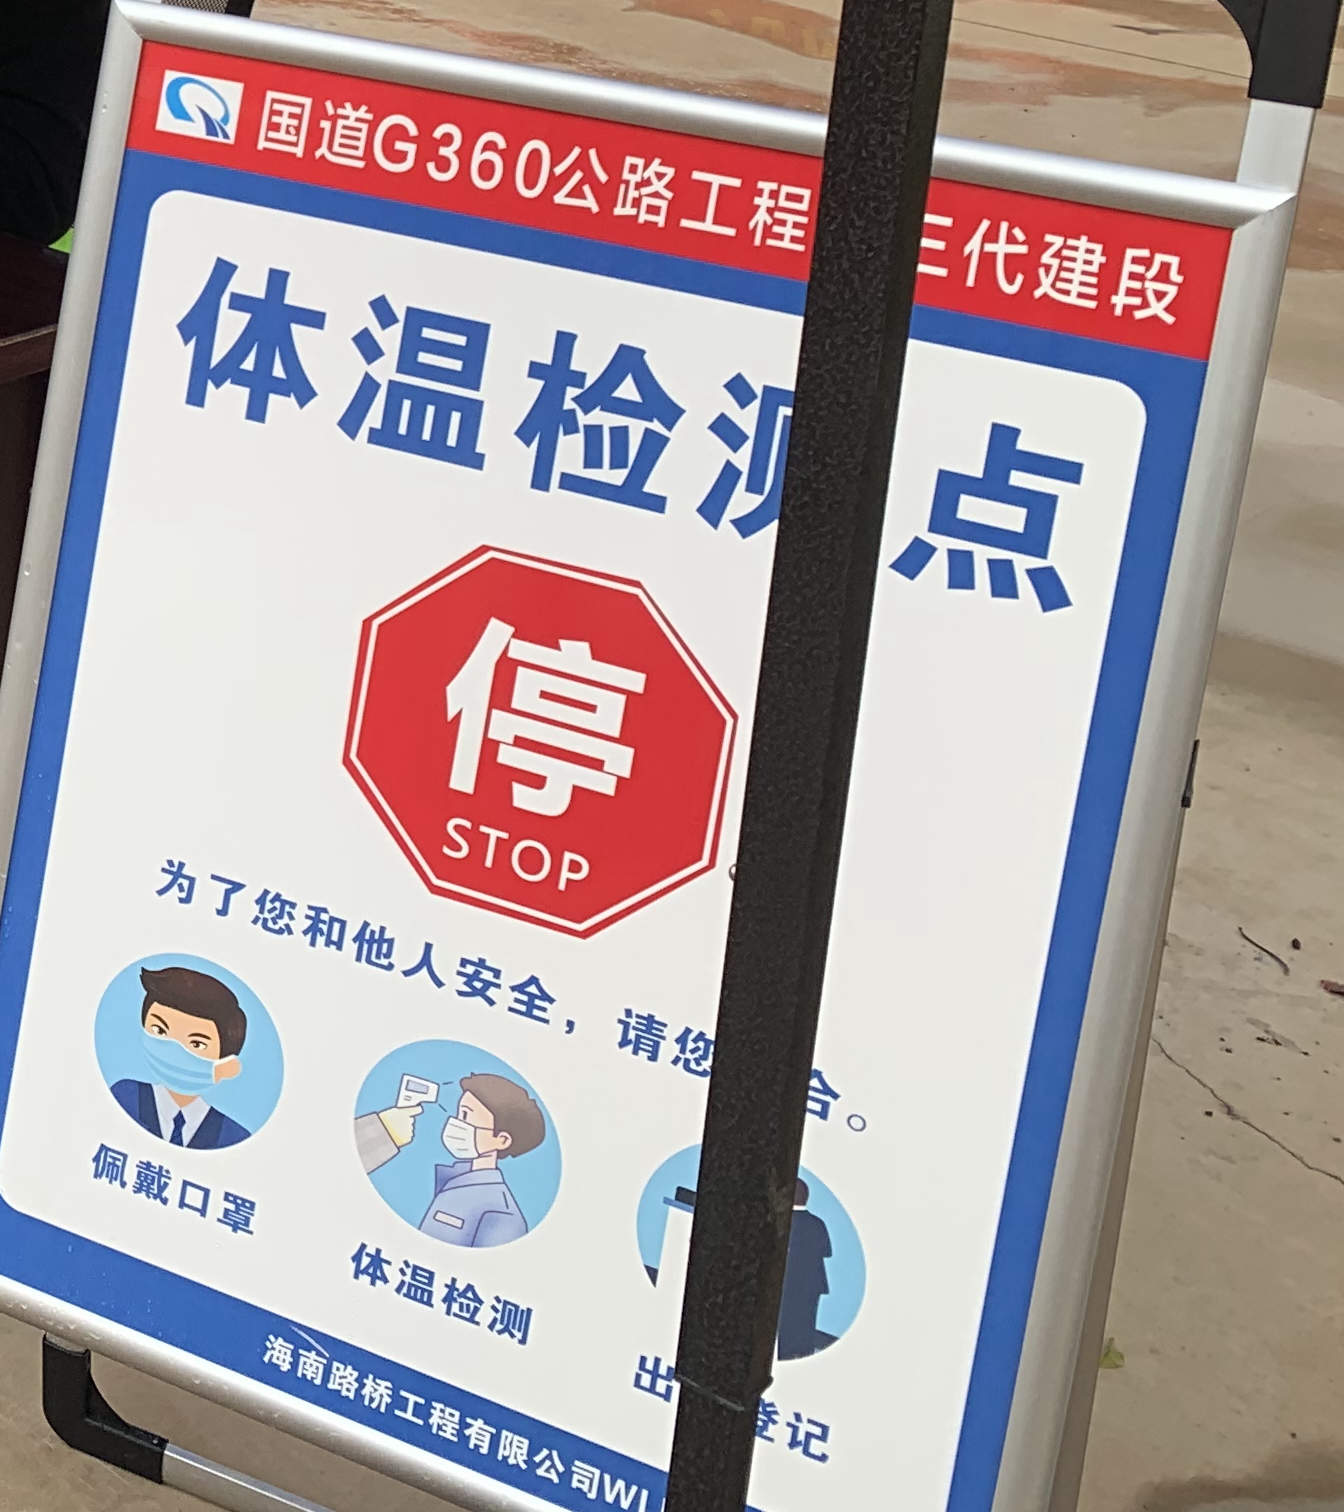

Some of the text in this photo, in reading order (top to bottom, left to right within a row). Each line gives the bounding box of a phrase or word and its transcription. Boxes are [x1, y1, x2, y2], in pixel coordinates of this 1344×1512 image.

[446, 617, 646, 817] 停
[442, 817, 590, 892] STOP
[91, 1143, 257, 1236] 佩戴口罩
[350, 1242, 533, 1346] 体温检测
[633, 1354, 830, 1464] 出登记
